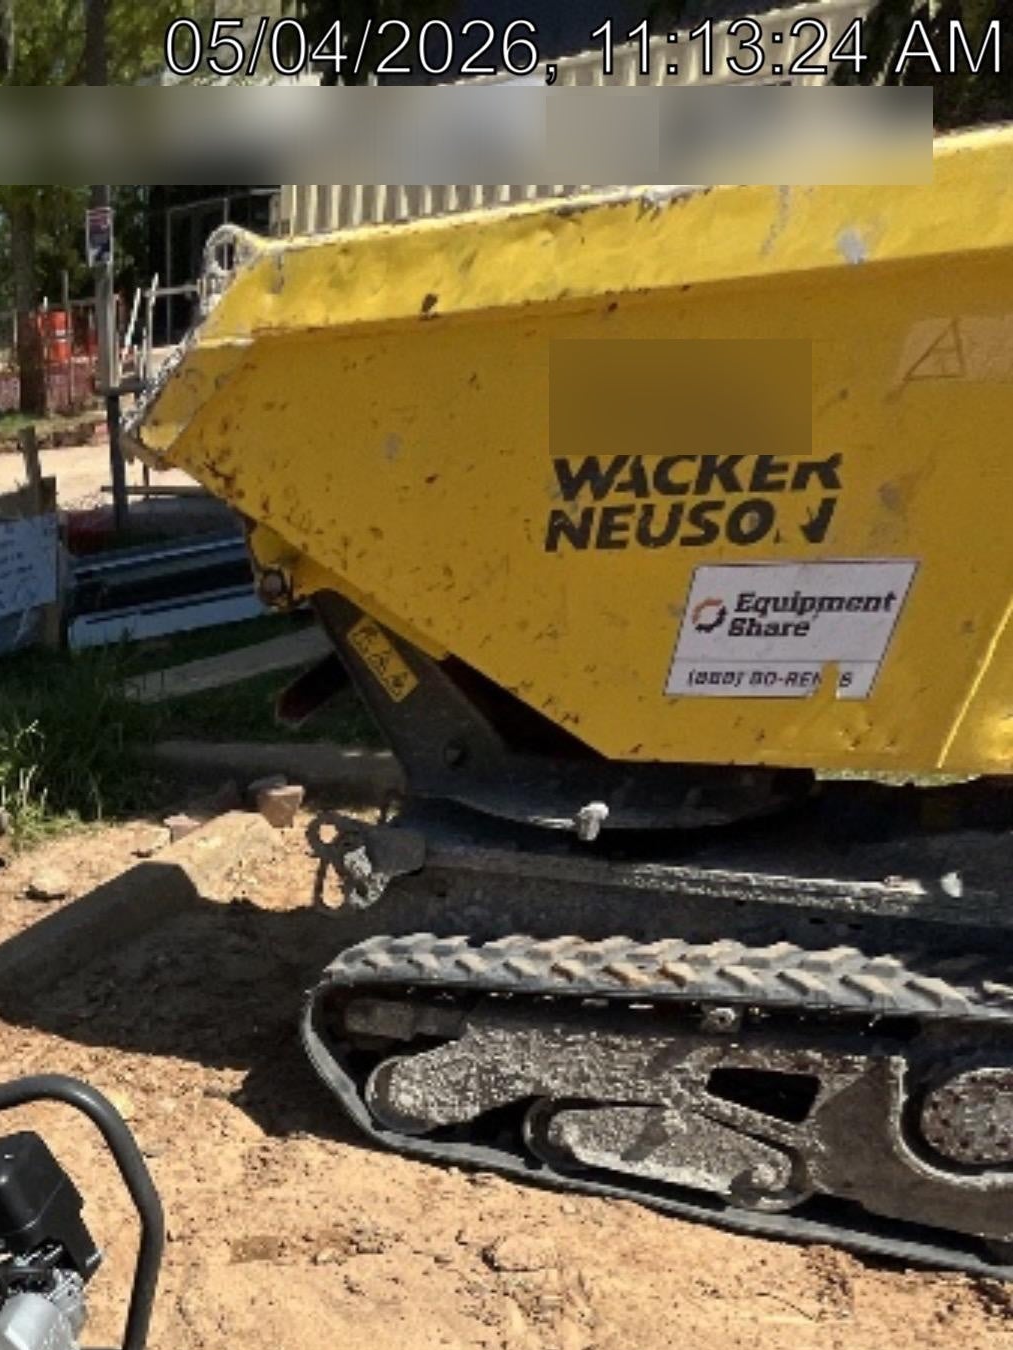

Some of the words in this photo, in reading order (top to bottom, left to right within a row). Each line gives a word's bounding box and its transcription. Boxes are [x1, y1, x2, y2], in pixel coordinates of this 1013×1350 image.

[553, 453, 843, 502] WACKER
[733, 591, 897, 616] Equipment
[727, 617, 810, 637] Share
